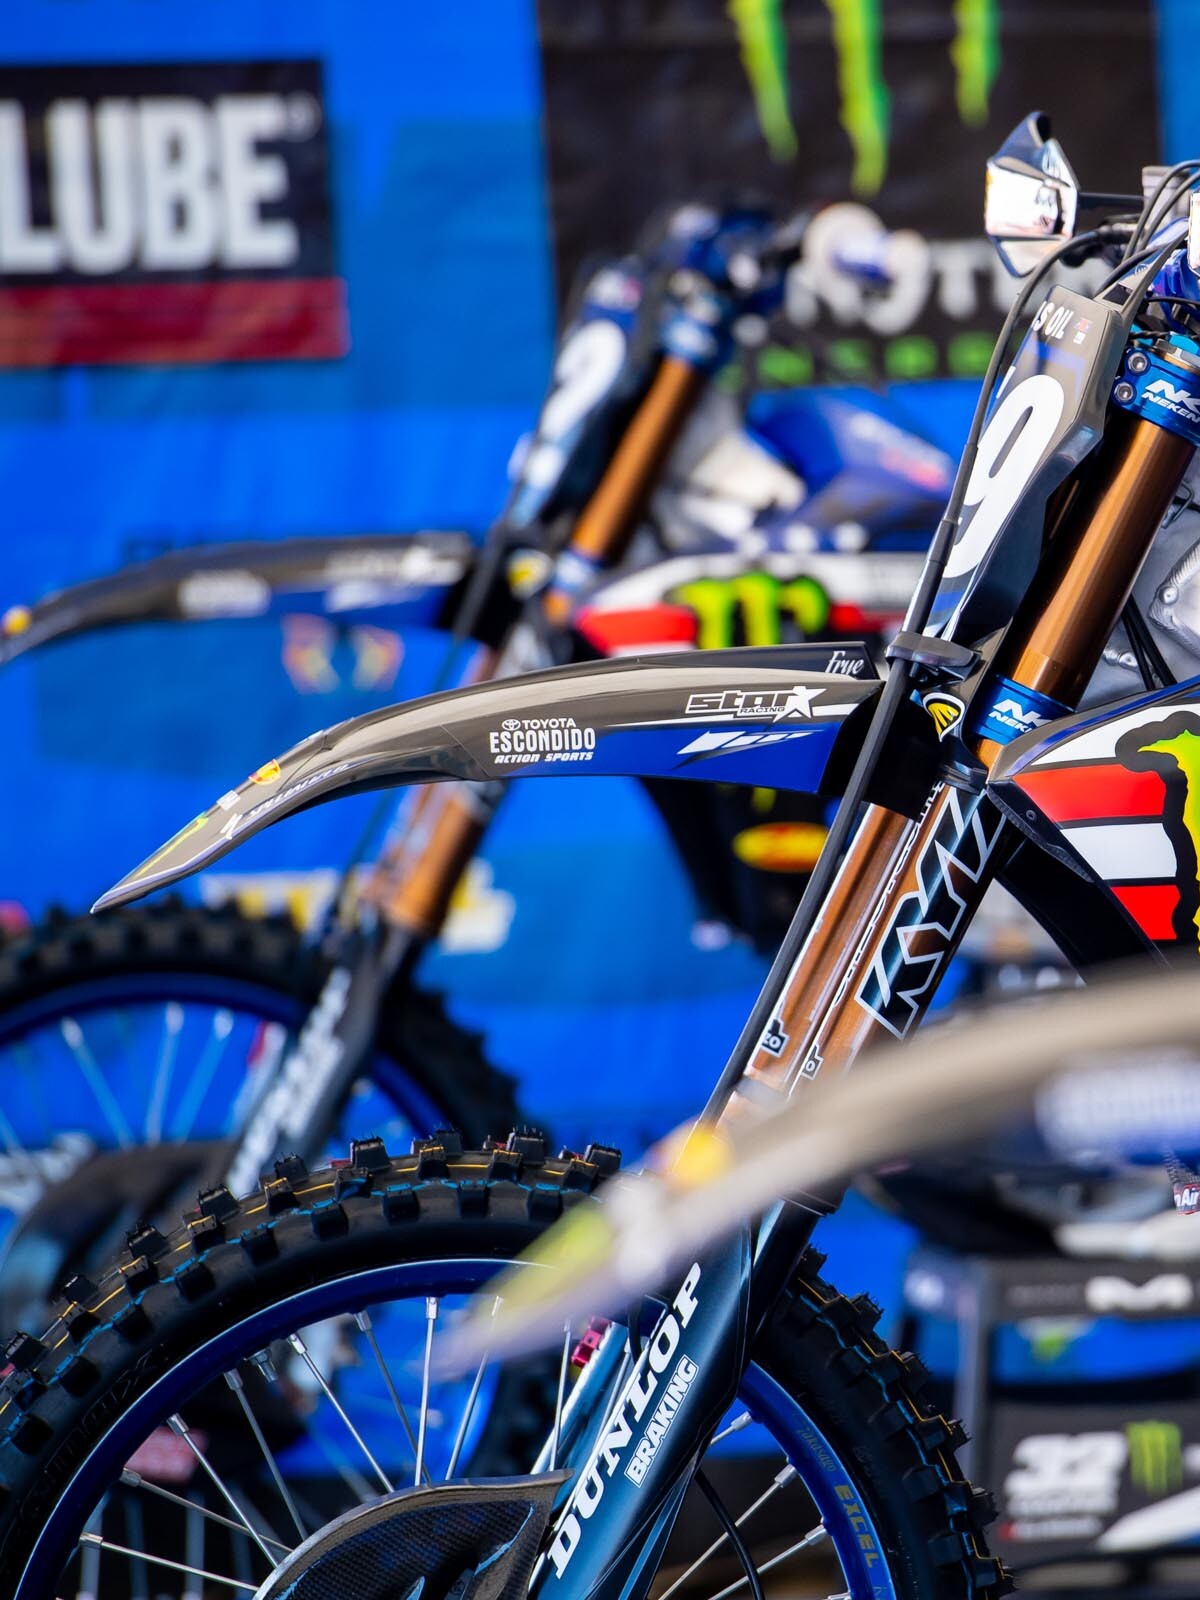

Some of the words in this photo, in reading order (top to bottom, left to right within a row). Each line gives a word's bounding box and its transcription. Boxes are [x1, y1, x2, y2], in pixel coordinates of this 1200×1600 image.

[1044, 306, 1074, 339] OIL
[522, 718, 576, 730] TOYOTA
[739, 706, 785, 714] RACING
[490, 728, 596, 753] ESCONDIDO
[494, 753, 541, 764] ACTION
[544, 751, 594, 762] SPORTS
[547, 1262, 702, 1580] DUNLOP
[624, 1354, 700, 1488] BRAKING
[834, 1484, 880, 1568] EXCEL
